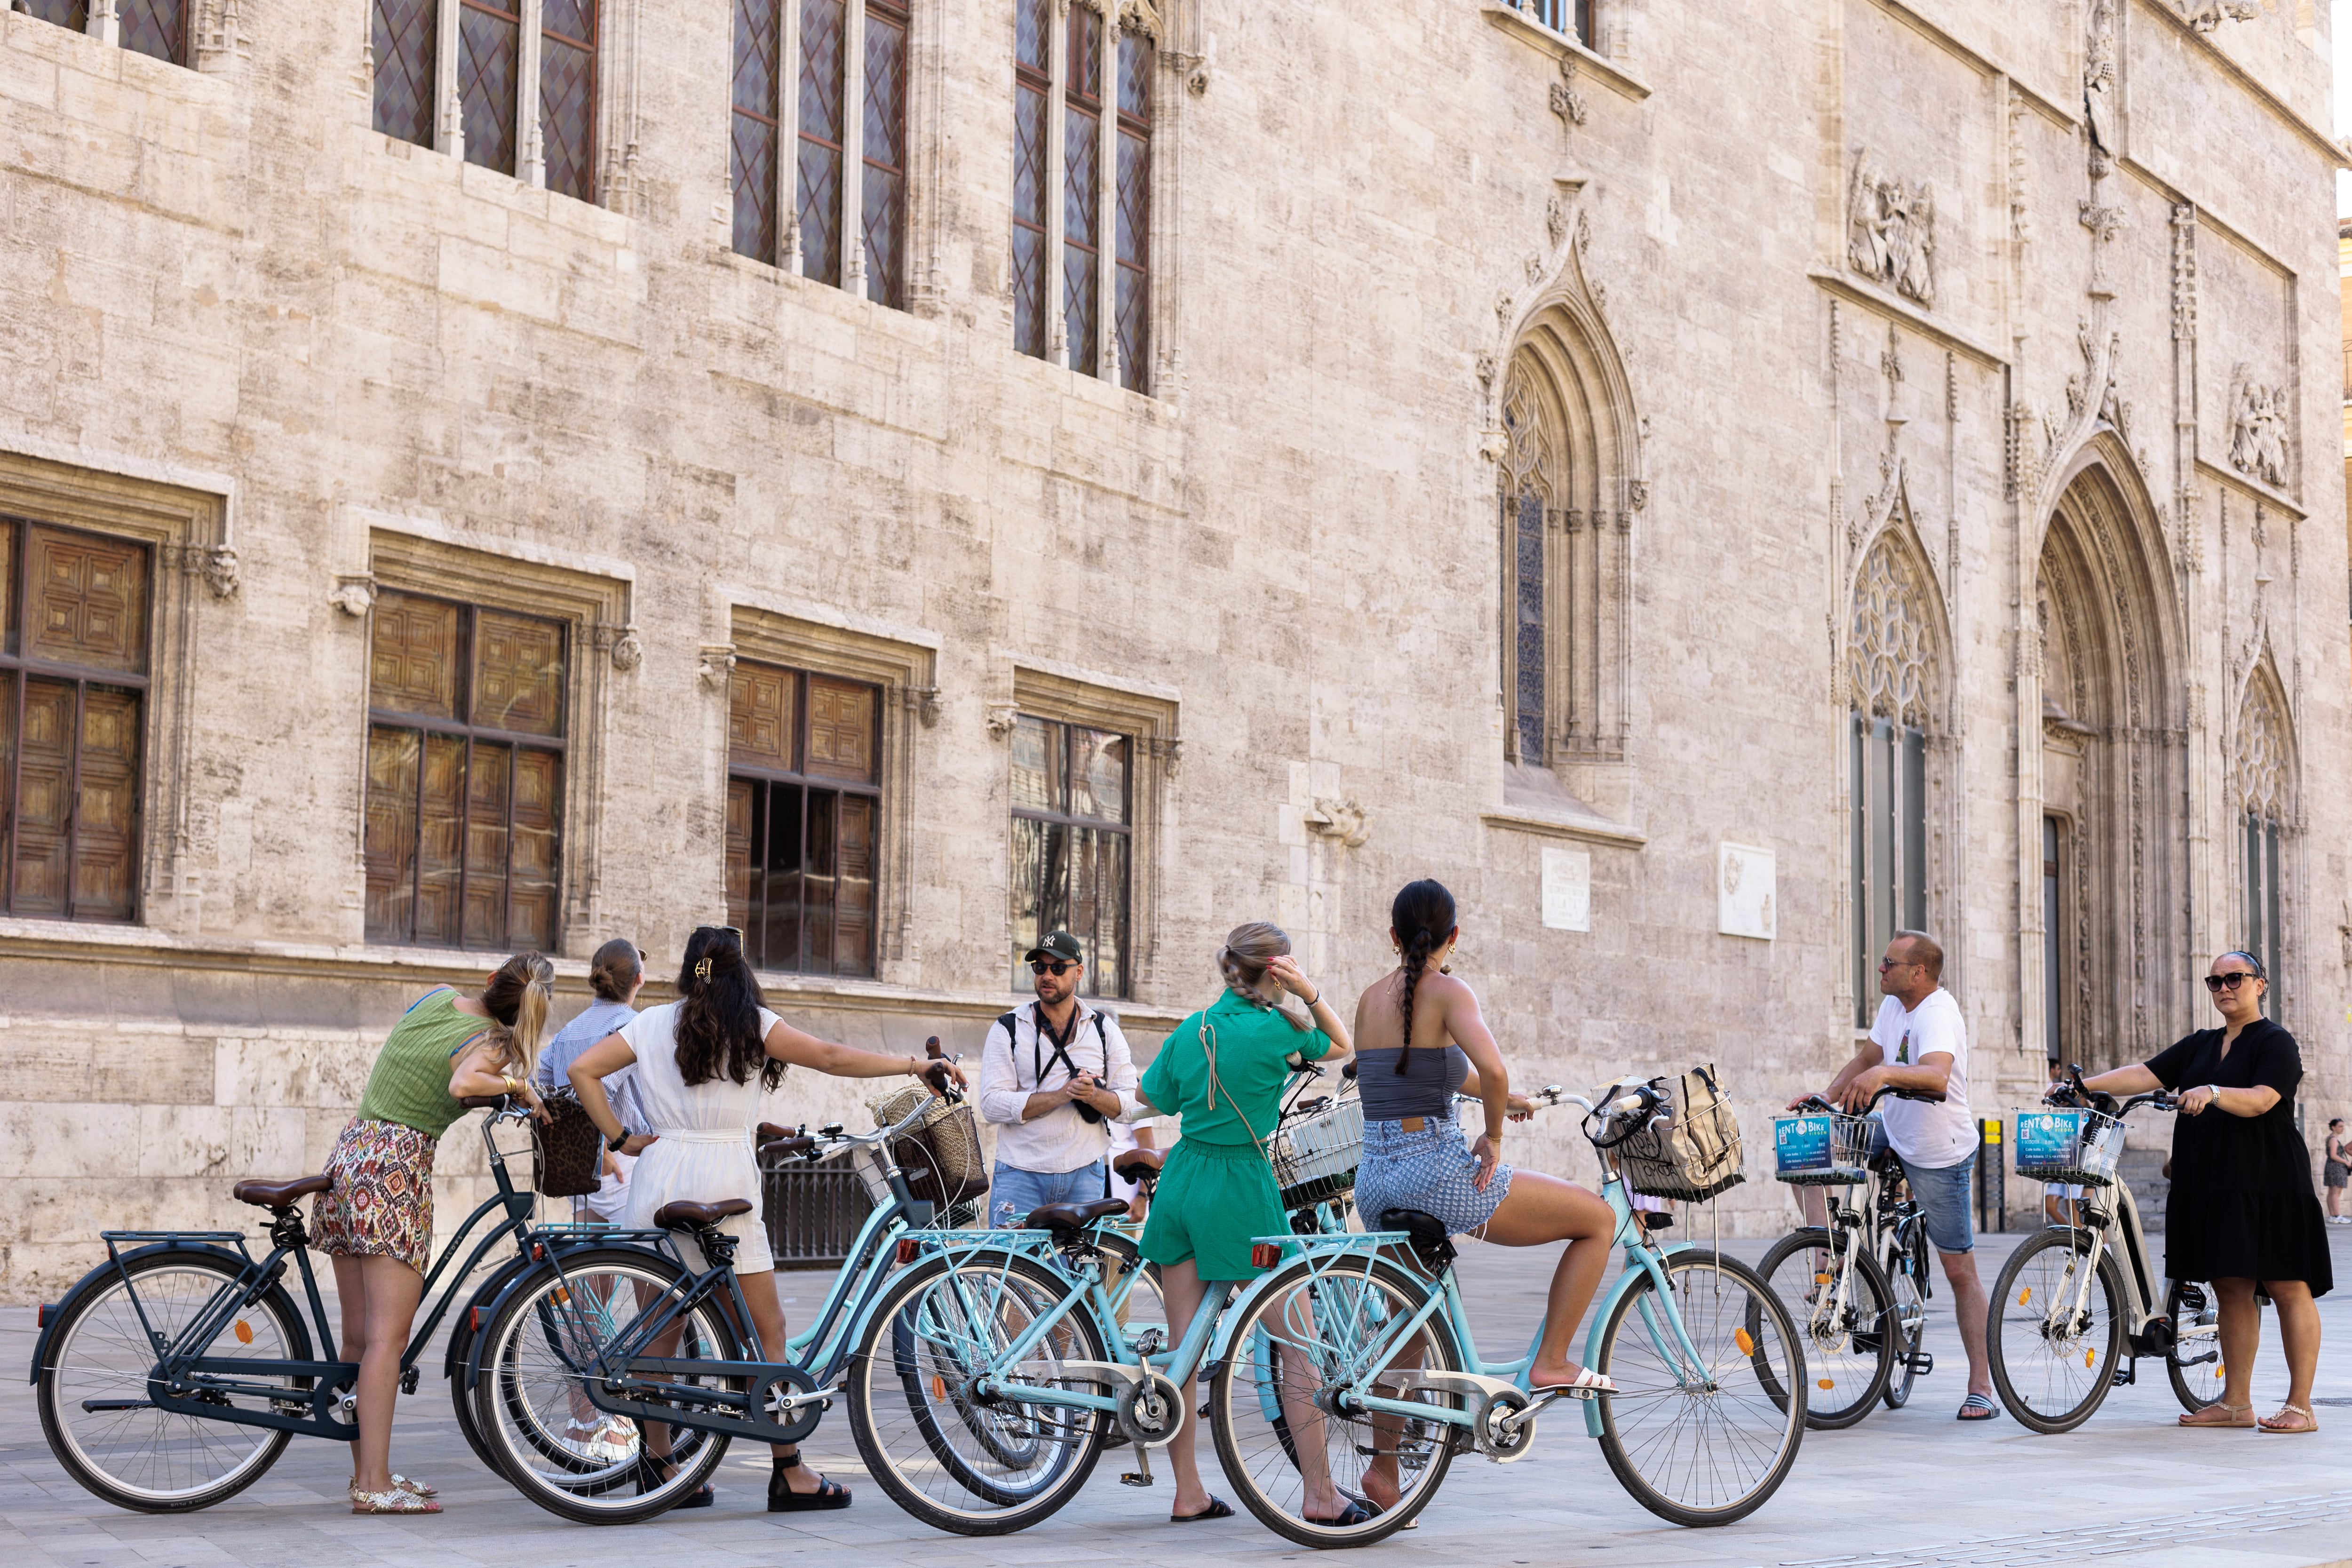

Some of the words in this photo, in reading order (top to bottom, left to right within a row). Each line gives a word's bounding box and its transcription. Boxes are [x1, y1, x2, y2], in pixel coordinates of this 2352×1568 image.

[1042, 935, 1056, 947] NY
[1779, 1123, 1796, 1135] RENT
[1808, 1122, 1824, 1132] BIKE
[2021, 1117, 2040, 1128] RENT
[2054, 1117, 2072, 1128] BIKE
[445, 1235, 462, 1260] ELOPS
[856, 1246, 870, 1272] ELOPS
[994, 1260, 1023, 1270] MARTHON
[1024, 1269, 1039, 1277] PLUS
[236, 1463, 263, 1487] SCHWALBE
[689, 1471, 701, 1484] PLUS
[195, 1489, 228, 1504] MARATHON
